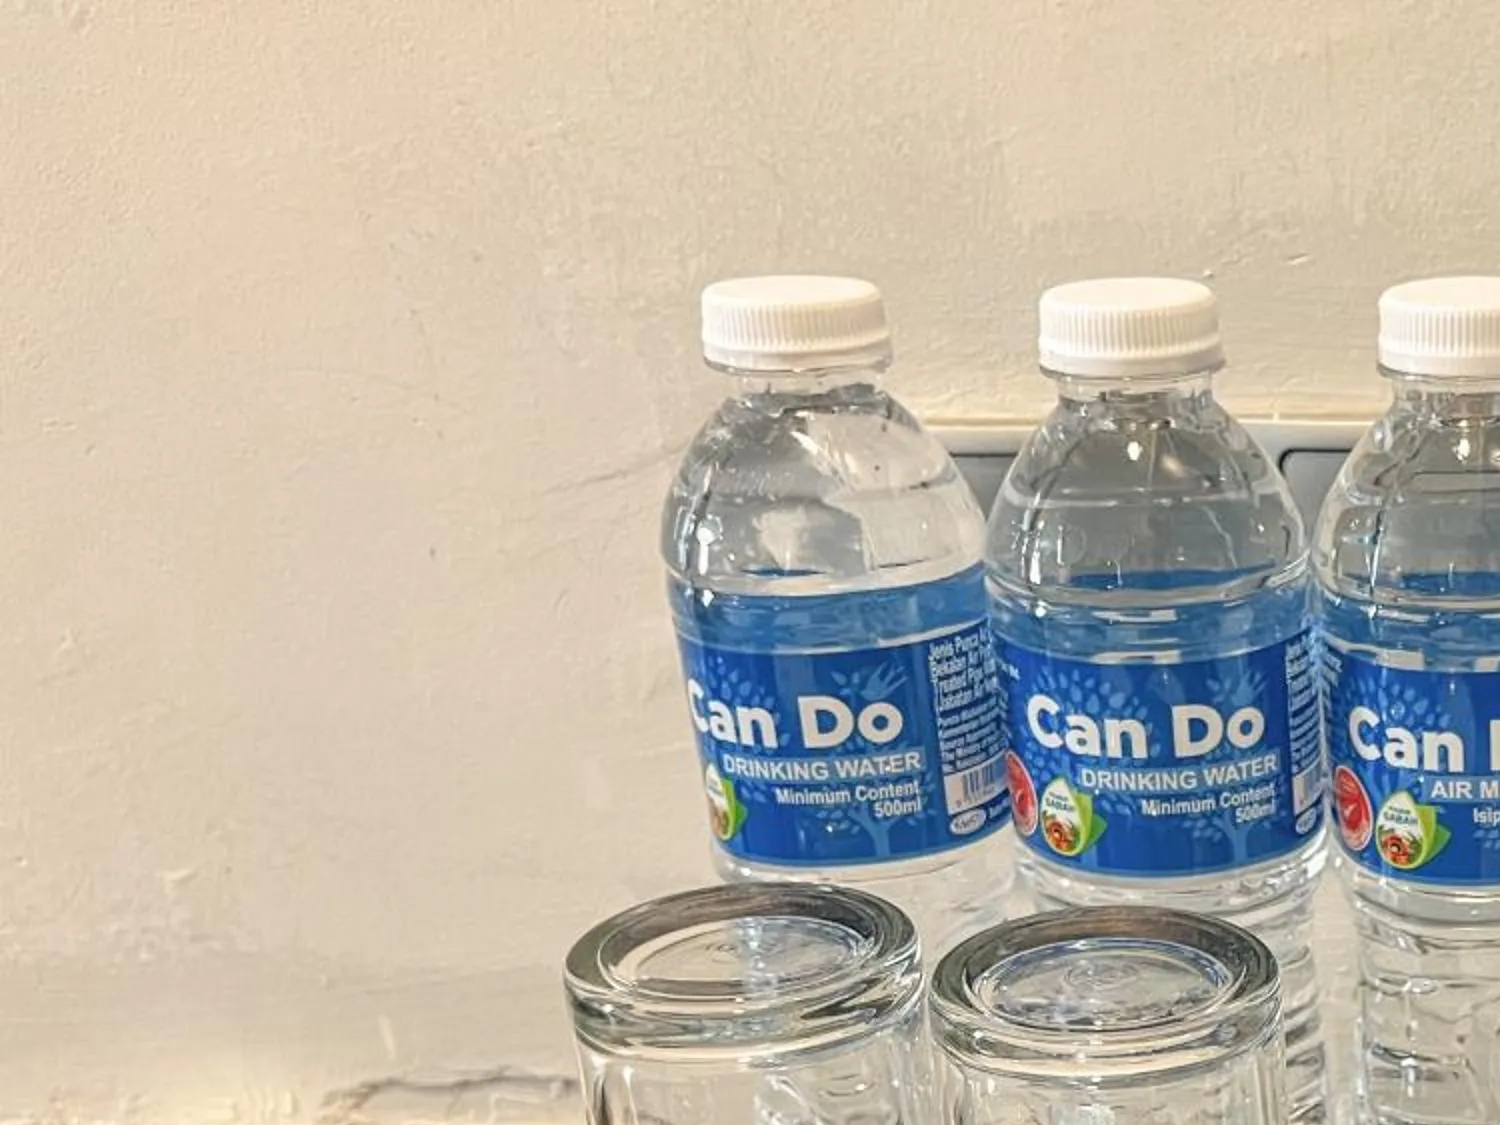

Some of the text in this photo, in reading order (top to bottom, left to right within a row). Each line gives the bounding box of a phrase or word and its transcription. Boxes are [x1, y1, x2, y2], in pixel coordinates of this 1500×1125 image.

[687, 677, 779, 749] Can
[797, 695, 904, 749] Do
[1026, 693, 1148, 759] Can
[1171, 703, 1265, 759] Do
[1349, 705, 1465, 773] Can
[723, 750, 922, 782] DRINKING WATER
[1080, 754, 1278, 792] DRINKING WATER
[775, 778, 920, 805] Minimum Content
[1141, 783, 1276, 816] Minimum Content
[1430, 778, 1473, 800] AIR
[873, 797, 922, 818] 500ml
[1235, 799, 1276, 824] 500ml
